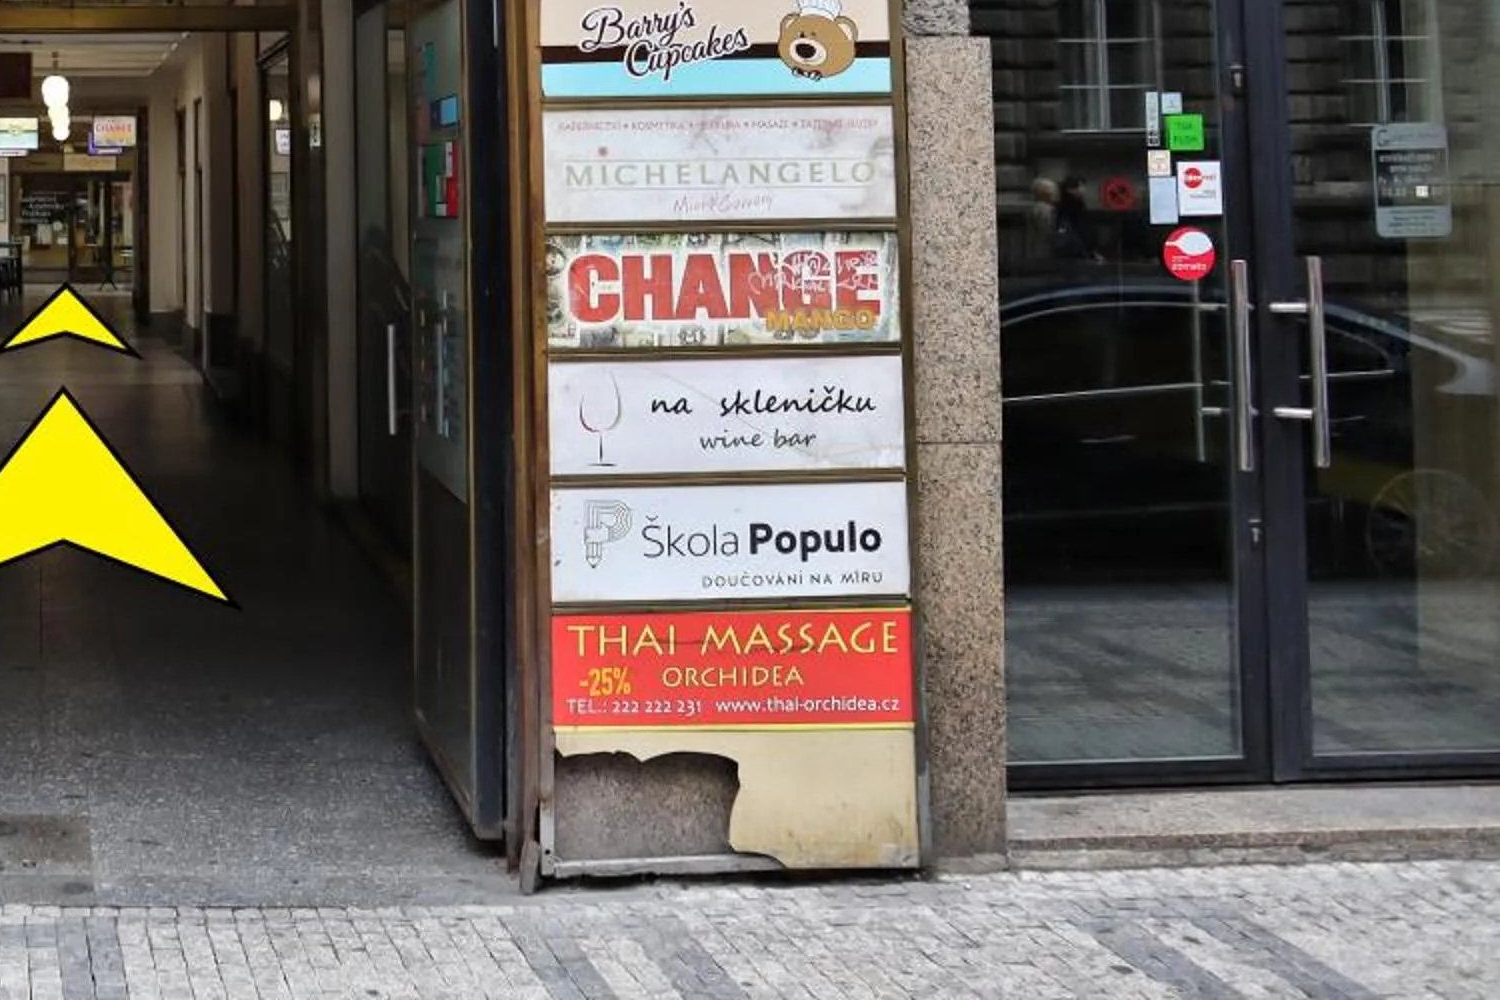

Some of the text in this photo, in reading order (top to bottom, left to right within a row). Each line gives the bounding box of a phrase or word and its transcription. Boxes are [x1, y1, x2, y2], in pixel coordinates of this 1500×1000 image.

[579, 1, 696, 53] Barry's
[623, 24, 750, 82] Cupcakes
[564, 160, 878, 188] MICHELANGELO
[568, 250, 881, 324] CHANGE
[650, 385, 877, 417] na skleničku
[699, 428, 817, 450] wine bar
[642, 515, 740, 558] Škola
[749, 520, 883, 563] Populo
[701, 569, 884, 589] DOUČOVÁNÍ NA MÍRU
[567, 621, 899, 657] THAI MASSAGE
[579, 665, 805, 697] -25% ORCHIDEA
[611, 699, 639, 714] 222
[644, 699, 672, 714] 222
[676, 699, 702, 717] 231
[714, 696, 901, 714] www.thai-orchidea.cz
